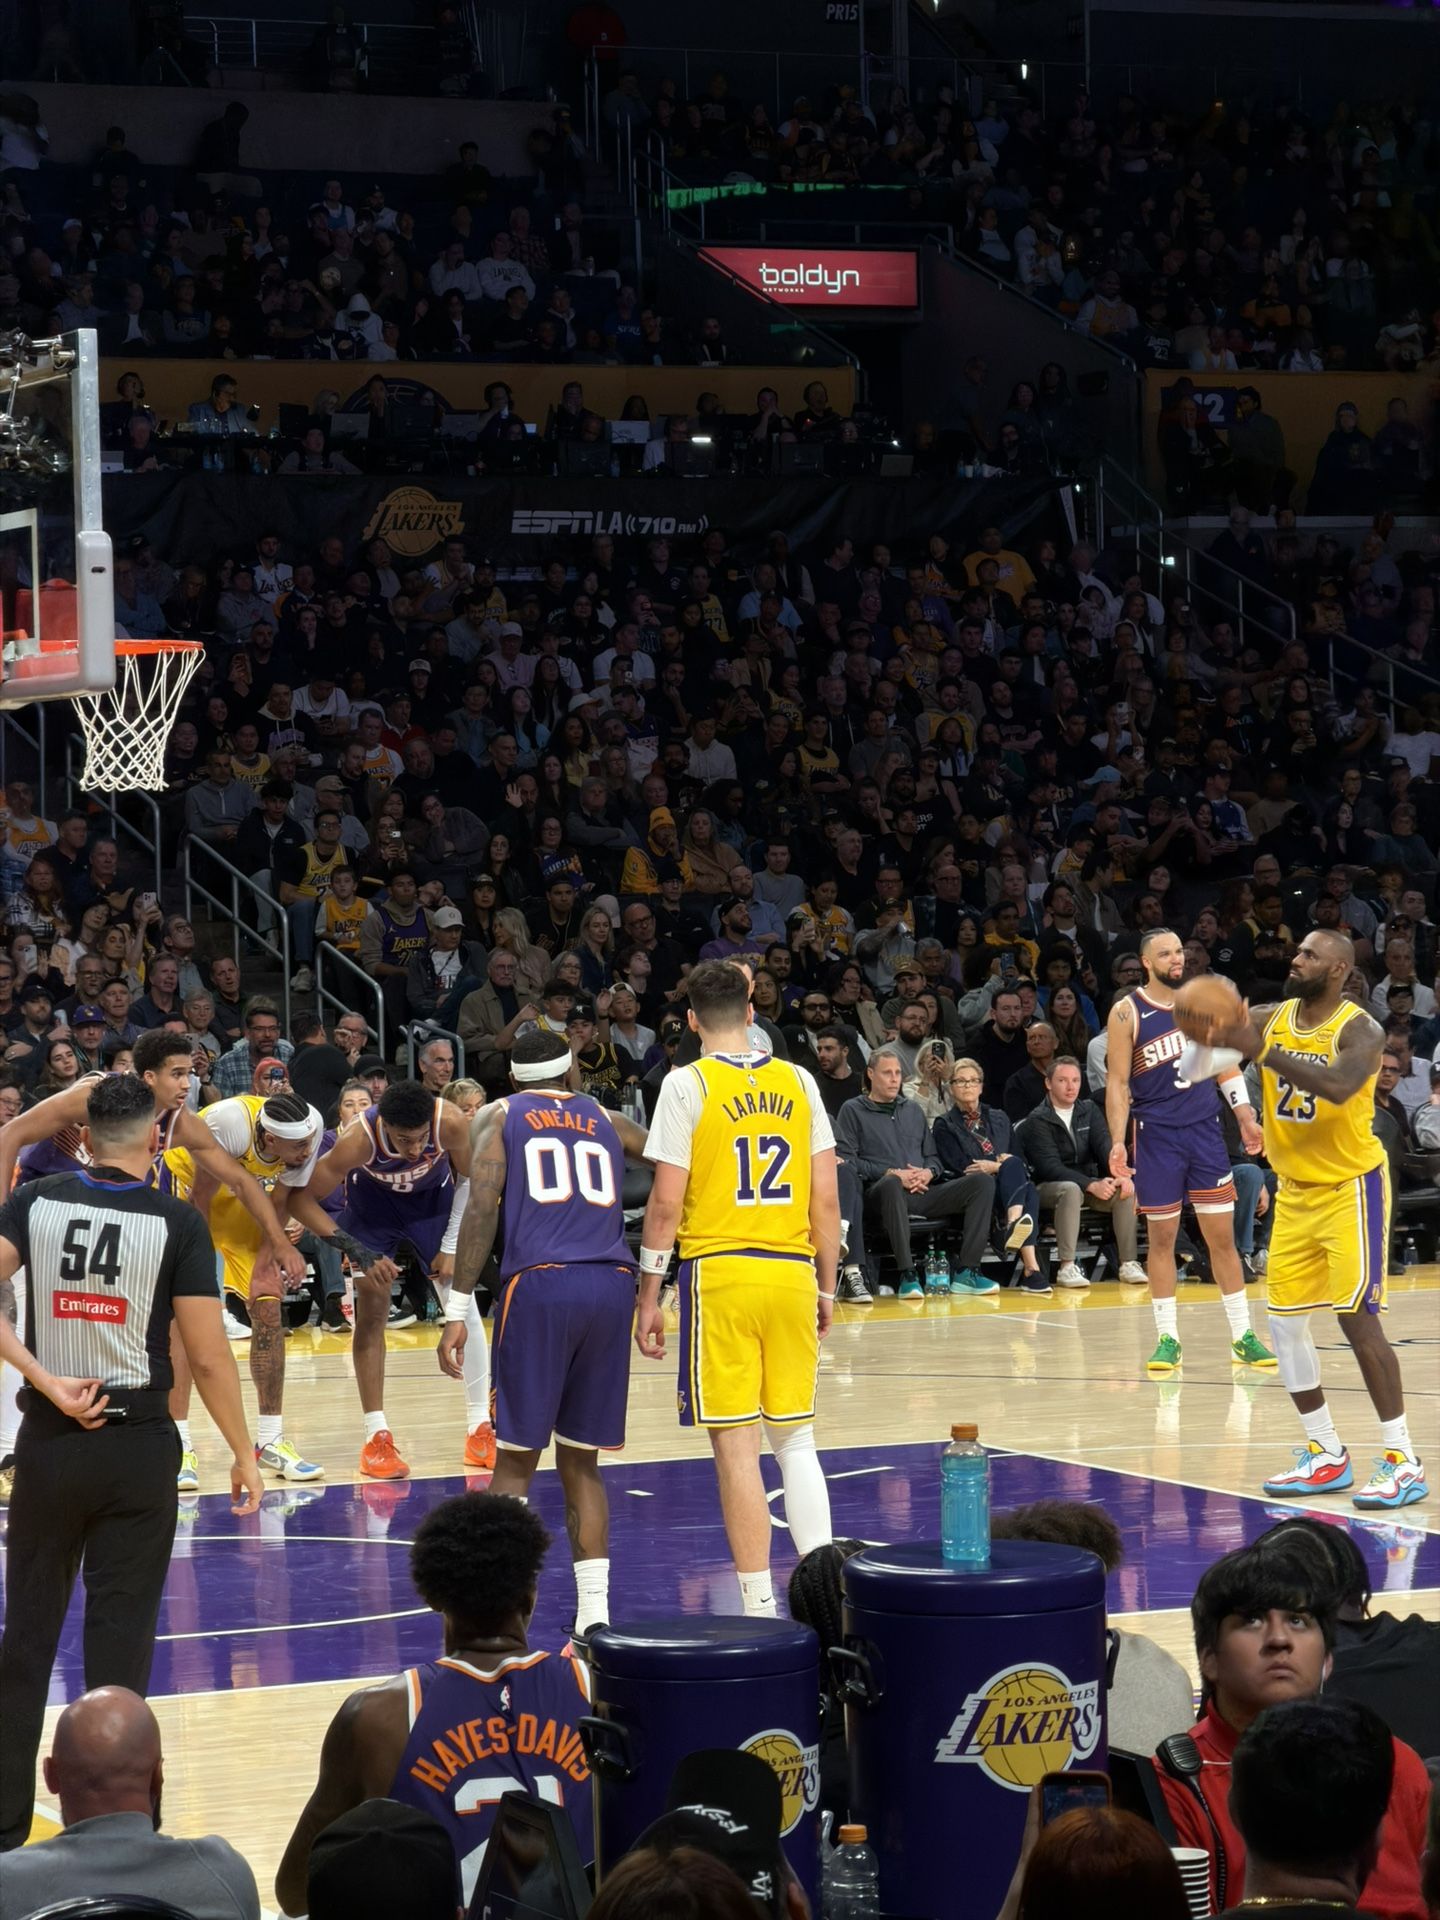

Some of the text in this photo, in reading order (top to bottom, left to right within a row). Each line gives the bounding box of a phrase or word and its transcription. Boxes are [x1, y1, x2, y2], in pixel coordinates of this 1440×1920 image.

[826, 3, 858, 20] PR15
[758, 262, 860, 294] boldyn
[373, 504, 457, 539] LAKERS
[1143, 1031, 1187, 1067] SUN
[722, 1091, 794, 1123] LARAVIA
[1277, 1075, 1316, 1122] 23
[525, 1109, 598, 1136] O'NEALE
[524, 1137, 616, 1208] 00
[734, 1134, 793, 1206] 12
[60, 1219, 121, 1285] 54
[60, 1298, 119, 1316] Emirates
[1003, 1687, 1096, 1708] LOS ANGELES
[945, 1698, 1095, 1756] LAKERS
[410, 1713, 592, 1793] HAYES-DAVIS
